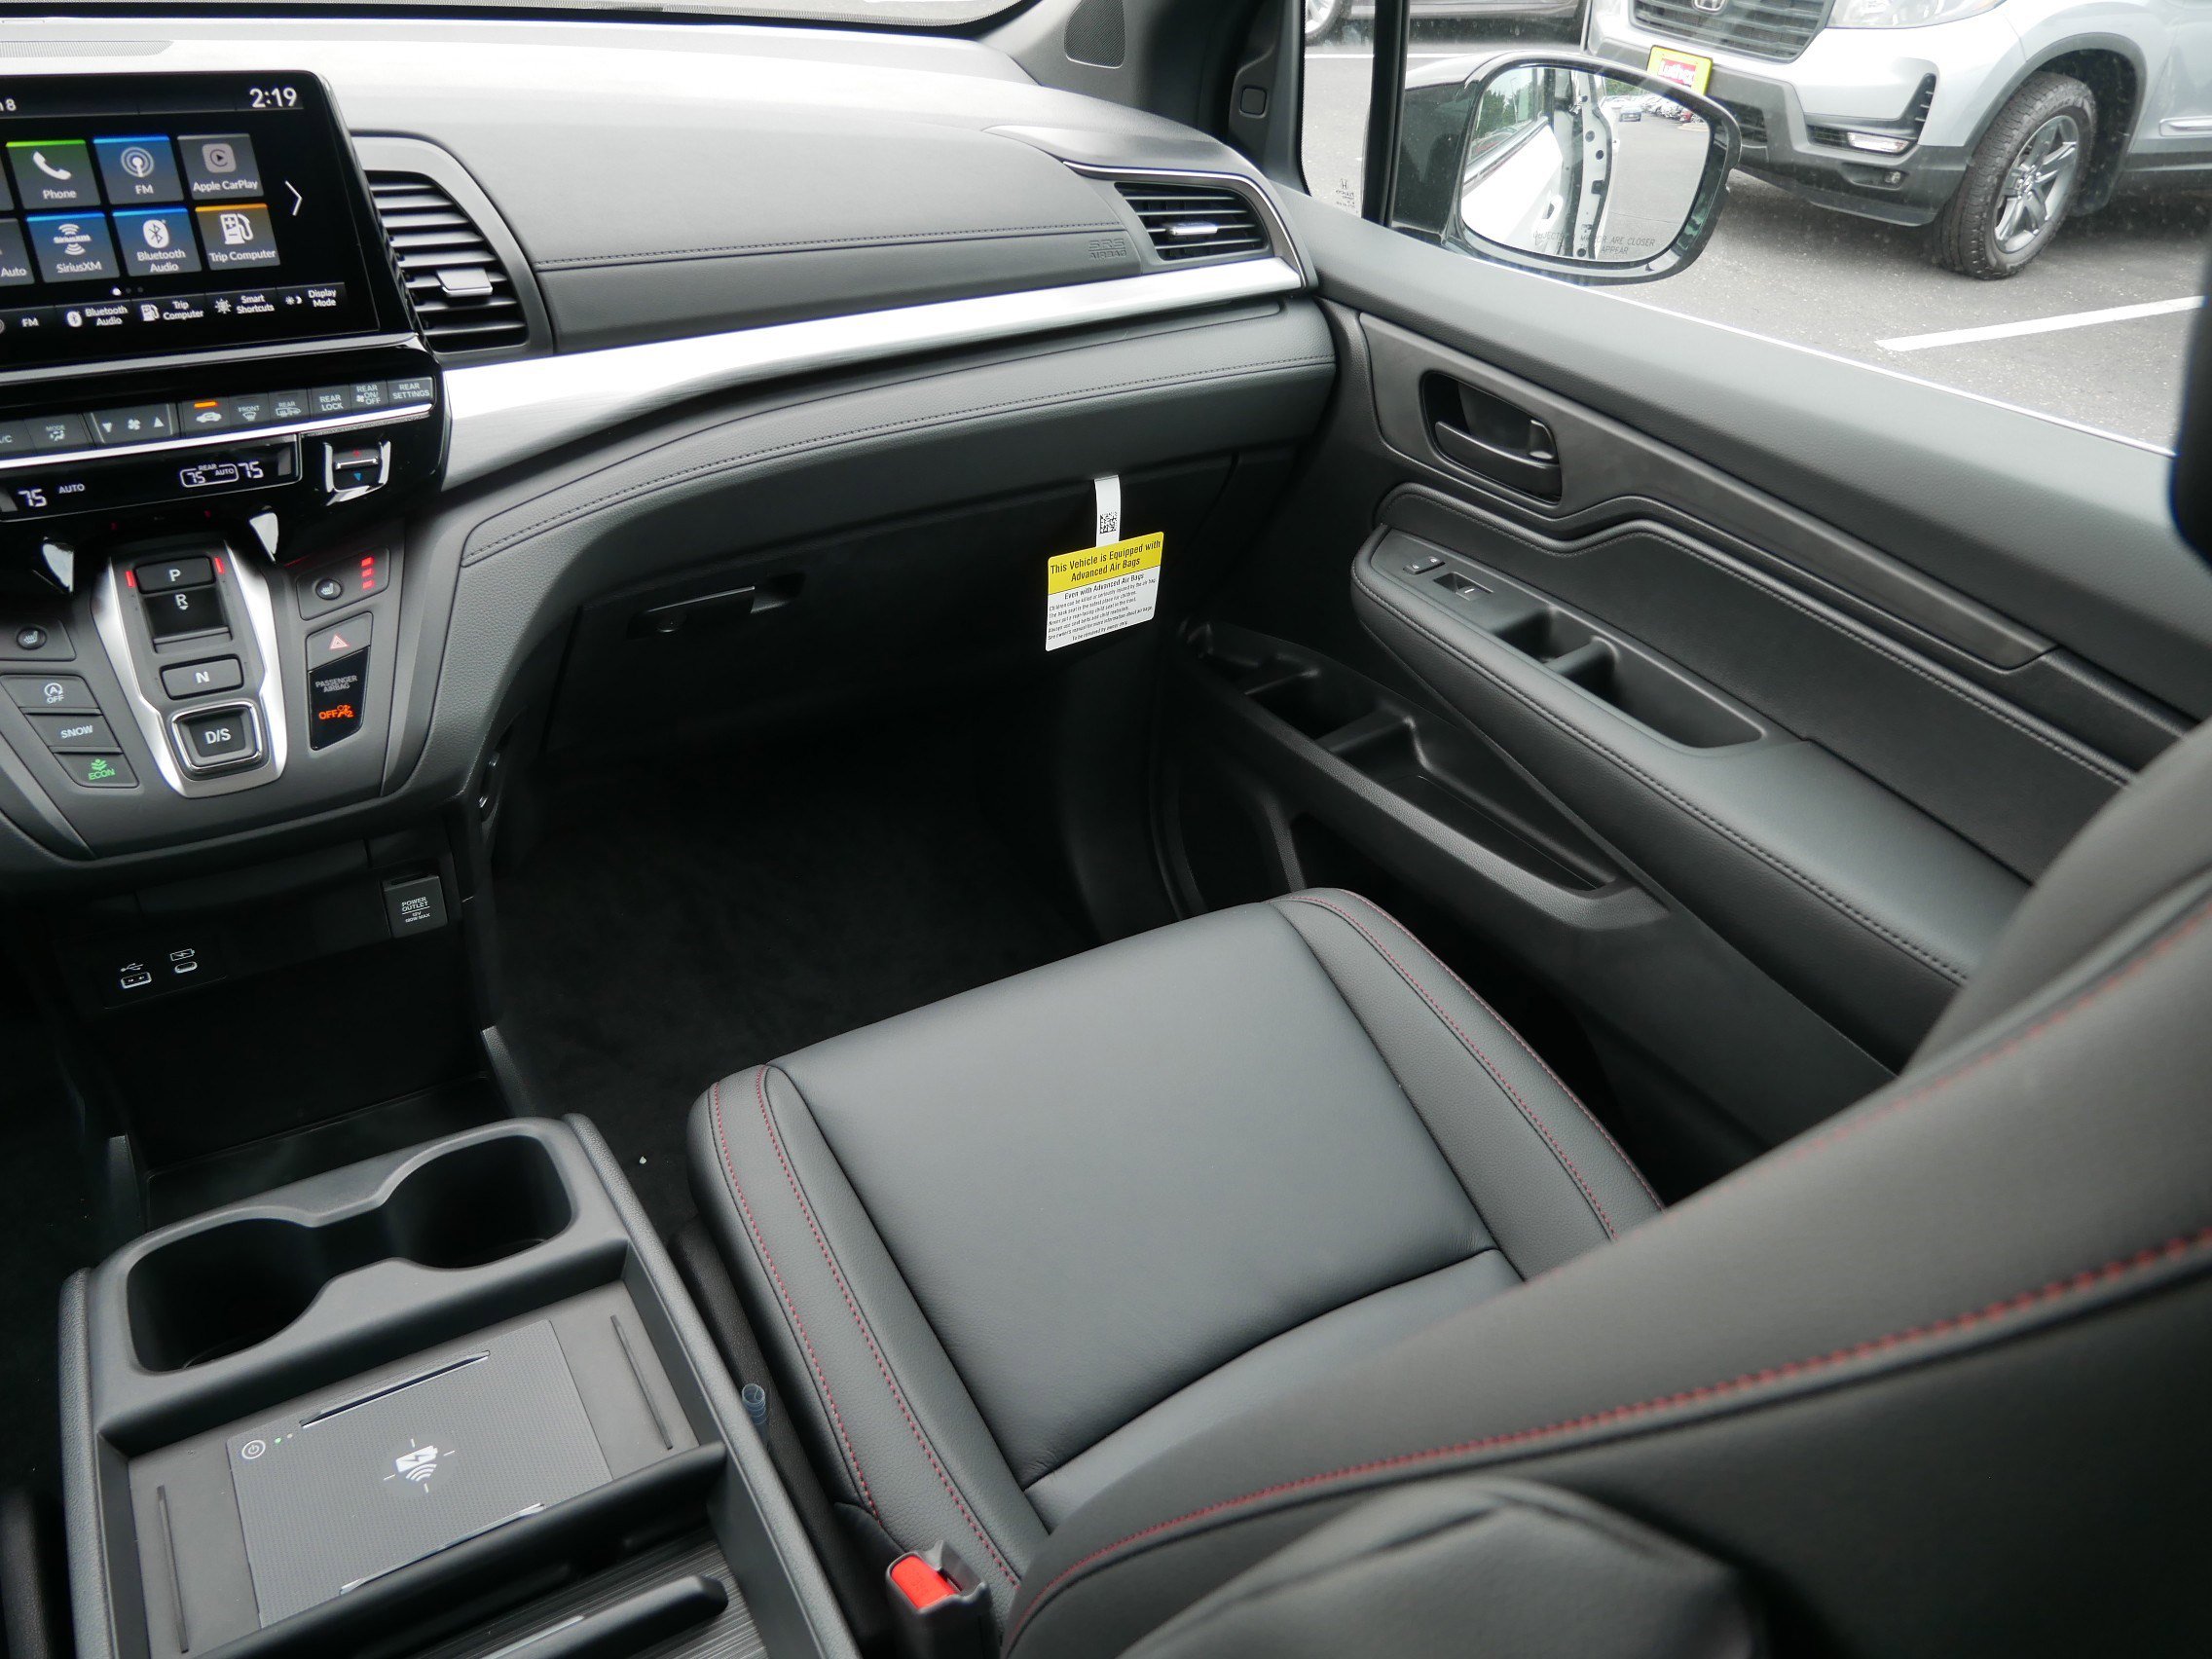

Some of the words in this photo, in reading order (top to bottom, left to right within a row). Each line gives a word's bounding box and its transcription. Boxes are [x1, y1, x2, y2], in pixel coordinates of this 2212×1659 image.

[249, 87, 298, 108] 2:19
[134, 184, 154, 194] FM
[193, 181, 221, 192] Apple
[222, 179, 258, 191] CarPlay
[43, 188, 77, 200] Phone
[1088, 239, 1125, 249] SRS
[1610, 236, 1624, 245] ARE
[1627, 237, 1655, 246] CLOSER
[136, 248, 186, 262] Bluetooth
[209, 252, 228, 263] Trip
[229, 249, 276, 262] Computer
[0, 267, 27, 277] Auto
[56, 261, 102, 274] SiriusXM
[150, 263, 179, 274] Audio
[240, 294, 266, 304] Smart
[308, 289, 337, 300] Display
[172, 300, 190, 311] Trip
[236, 303, 276, 314] Shortcuts
[313, 298, 337, 308] Mode
[85, 305, 129, 317] Bluetooth
[163, 310, 204, 321] Computer
[21, 317, 39, 328] FM
[96, 315, 123, 326] Audio
[319, 394, 342, 403] REAR
[392, 388, 430, 401] SETTINGS
[365, 396, 381, 405] OFF
[321, 402, 344, 412] LOCK
[214, 467, 235, 476] AUTO
[238, 461, 265, 479] 75
[187, 471, 206, 484] 75
[58, 483, 86, 495] AUTO
[18, 488, 48, 508] 75
[1051, 563, 1067, 574] This
[1069, 555, 1098, 570] Vehicle
[1100, 553, 1107, 562] is
[1109, 544, 1143, 562] Equipped
[1145, 540, 1161, 551] with
[1071, 566, 1108, 582] Advanced
[1110, 562, 1121, 571] Air
[1123, 557, 1141, 571] Bags
[168, 569, 181, 582] P
[1065, 591, 1078, 600] Even
[1081, 587, 1091, 596] with
[1093, 579, 1120, 592] Advanced
[1130, 573, 1144, 583] Bags
[174, 594, 188, 608] R
[195, 670, 210, 684] N
[314, 675, 358, 688] PASSENGER
[323, 682, 350, 693] AIRBAG
[47, 694, 64, 704] OFF
[318, 709, 338, 720] OFF
[60, 724, 93, 739] SNOW
[204, 728, 232, 745] D/S
[88, 768, 116, 781] ECON
[401, 896, 427, 906] POWER
[401, 901, 428, 912] OUTLET
